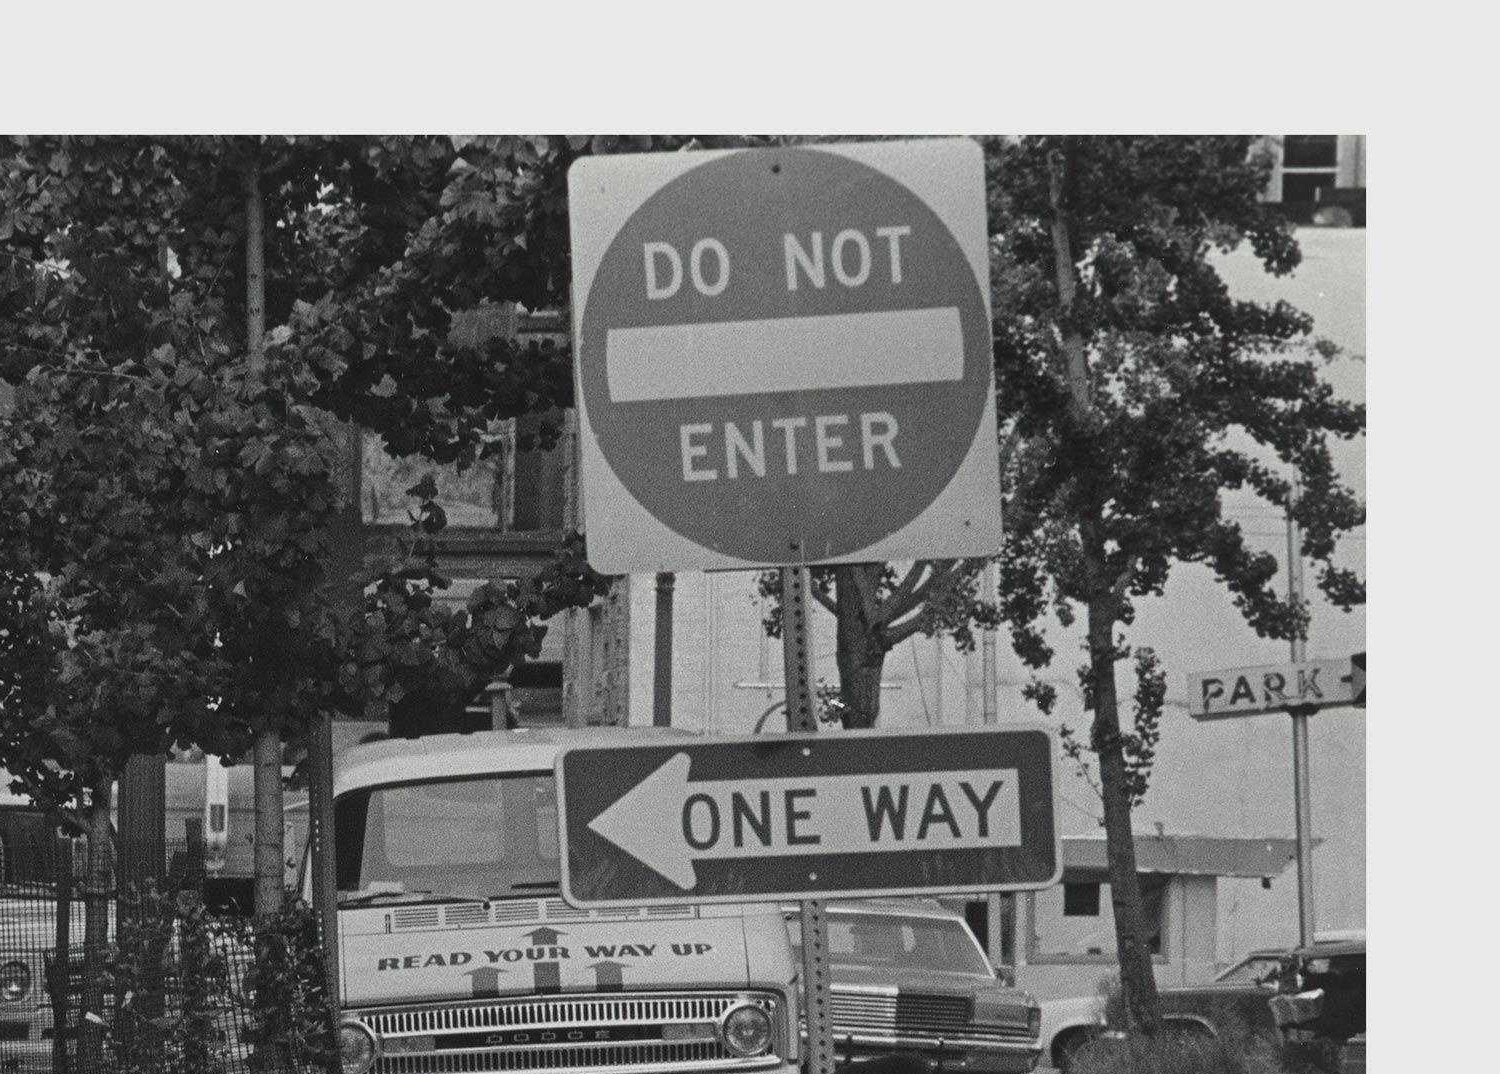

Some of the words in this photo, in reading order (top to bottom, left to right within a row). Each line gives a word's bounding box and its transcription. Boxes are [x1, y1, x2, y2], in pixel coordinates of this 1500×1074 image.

[643, 237, 731, 300] DO
[783, 225, 912, 292] NOT
[680, 410, 902, 483] ENTER
[1201, 667, 1324, 713] PARK
[681, 786, 822, 851] ONE
[860, 779, 1005, 843] WAY
[378, 951, 472, 971] READ
[483, 945, 572, 965] YOUR
[584, 942, 657, 958] WAY
[671, 942, 712, 956] UP
[486, 1030, 611, 1045] DODGE
